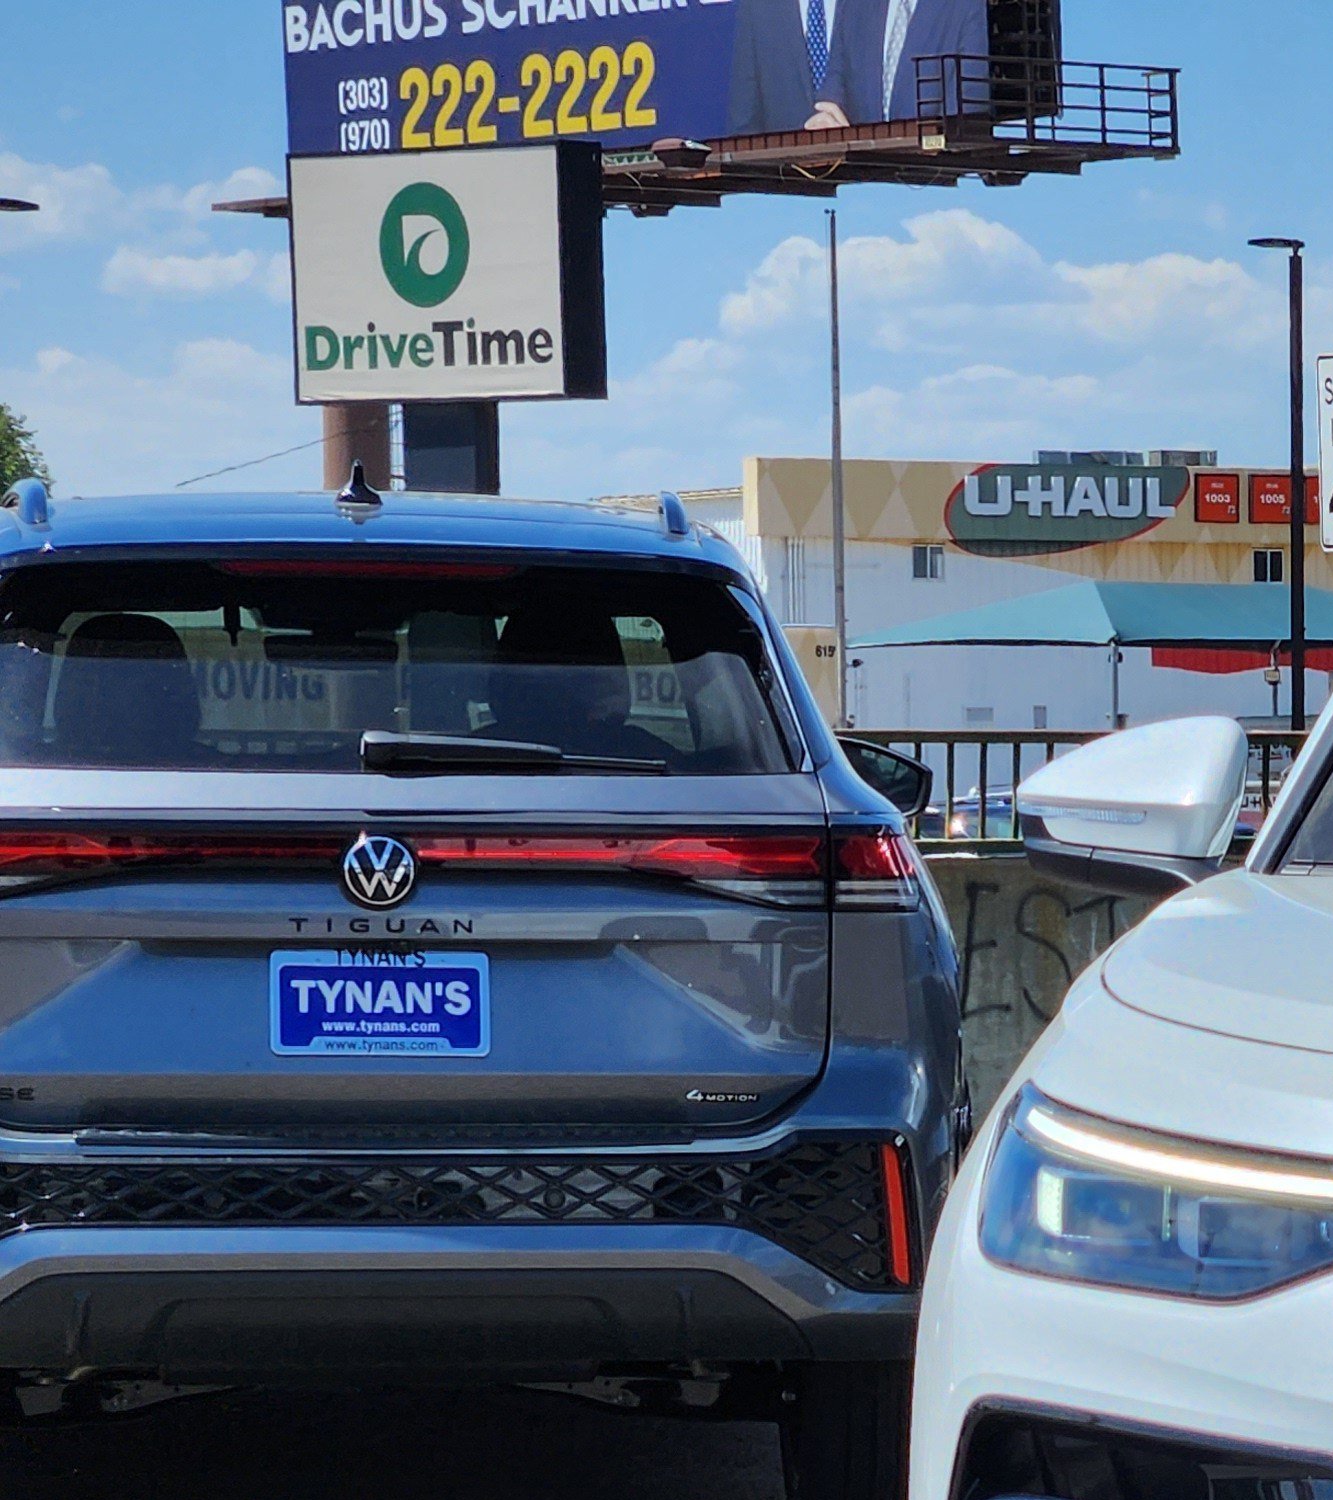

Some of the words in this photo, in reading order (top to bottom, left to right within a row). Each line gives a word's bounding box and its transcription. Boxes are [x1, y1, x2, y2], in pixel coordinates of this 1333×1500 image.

[285, 0, 449, 53] BACHUS
[338, 76, 388, 115] (303)
[399, 41, 657, 149] 222-2222
[340, 118, 391, 152] (970)
[304, 317, 553, 371] DriveTime
[289, 917, 474, 934] TIGUAN
[290, 979, 472, 1016] TYNAN'S
[321, 1019, 441, 1034] www.tynans.com
[324, 1036, 438, 1052] www.tynans.com
